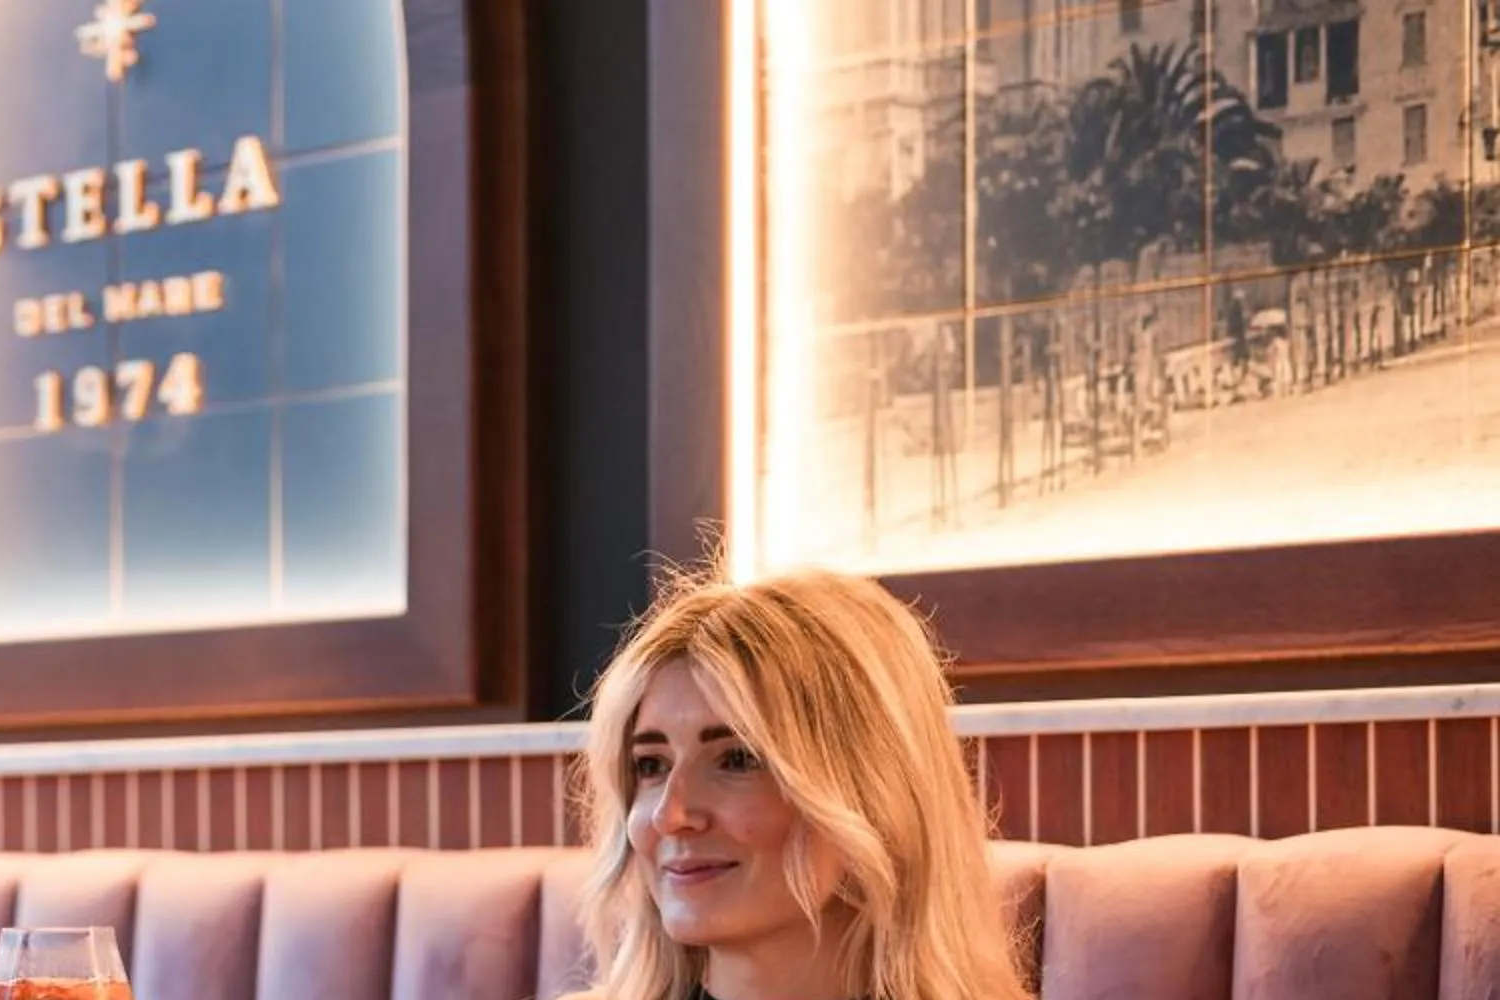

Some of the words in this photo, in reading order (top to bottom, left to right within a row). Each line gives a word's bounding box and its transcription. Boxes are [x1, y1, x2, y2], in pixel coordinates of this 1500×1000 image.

[13, 290, 95, 337] DEL
[102, 269, 225, 323] MARE
[33, 351, 203, 432] 1974
